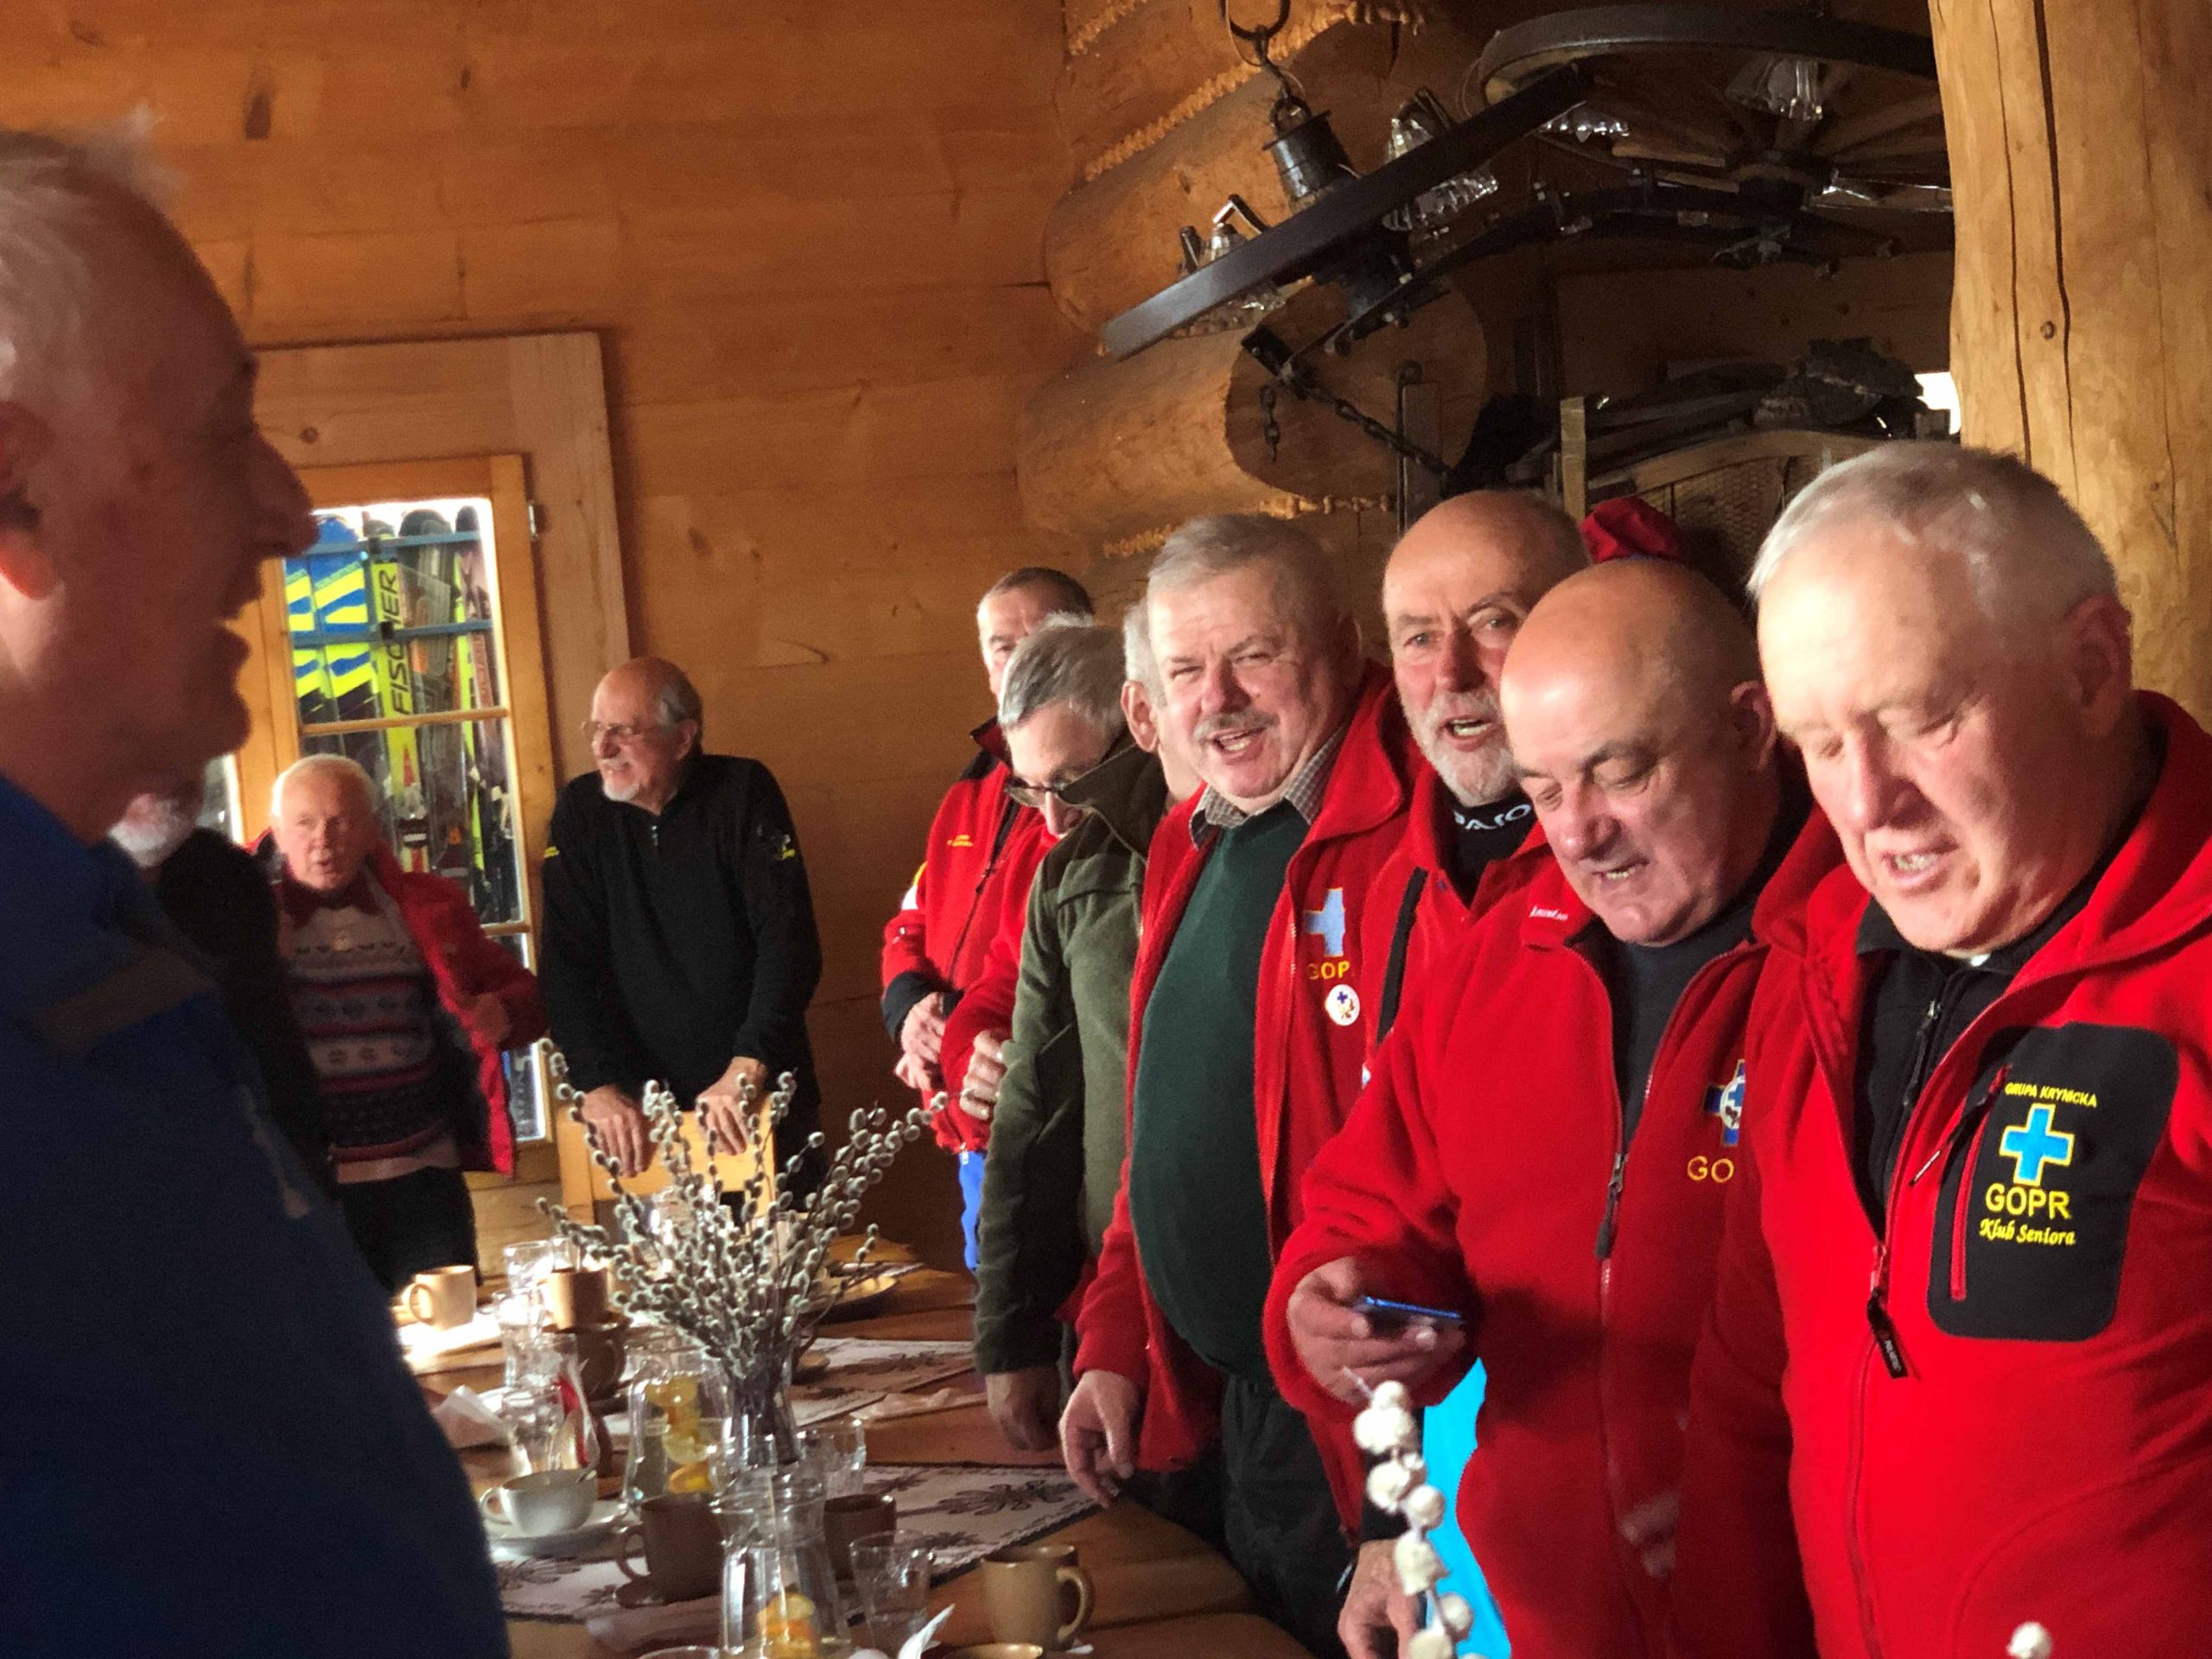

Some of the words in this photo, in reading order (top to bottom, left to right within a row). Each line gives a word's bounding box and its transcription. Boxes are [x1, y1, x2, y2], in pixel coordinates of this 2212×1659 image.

[2005, 1082, 2037, 1097] GRUPA
[1986, 1184, 2071, 1219] GOPR
[1980, 1218, 2015, 1241] Klub
[2018, 1224, 2075, 1245] Seniora
